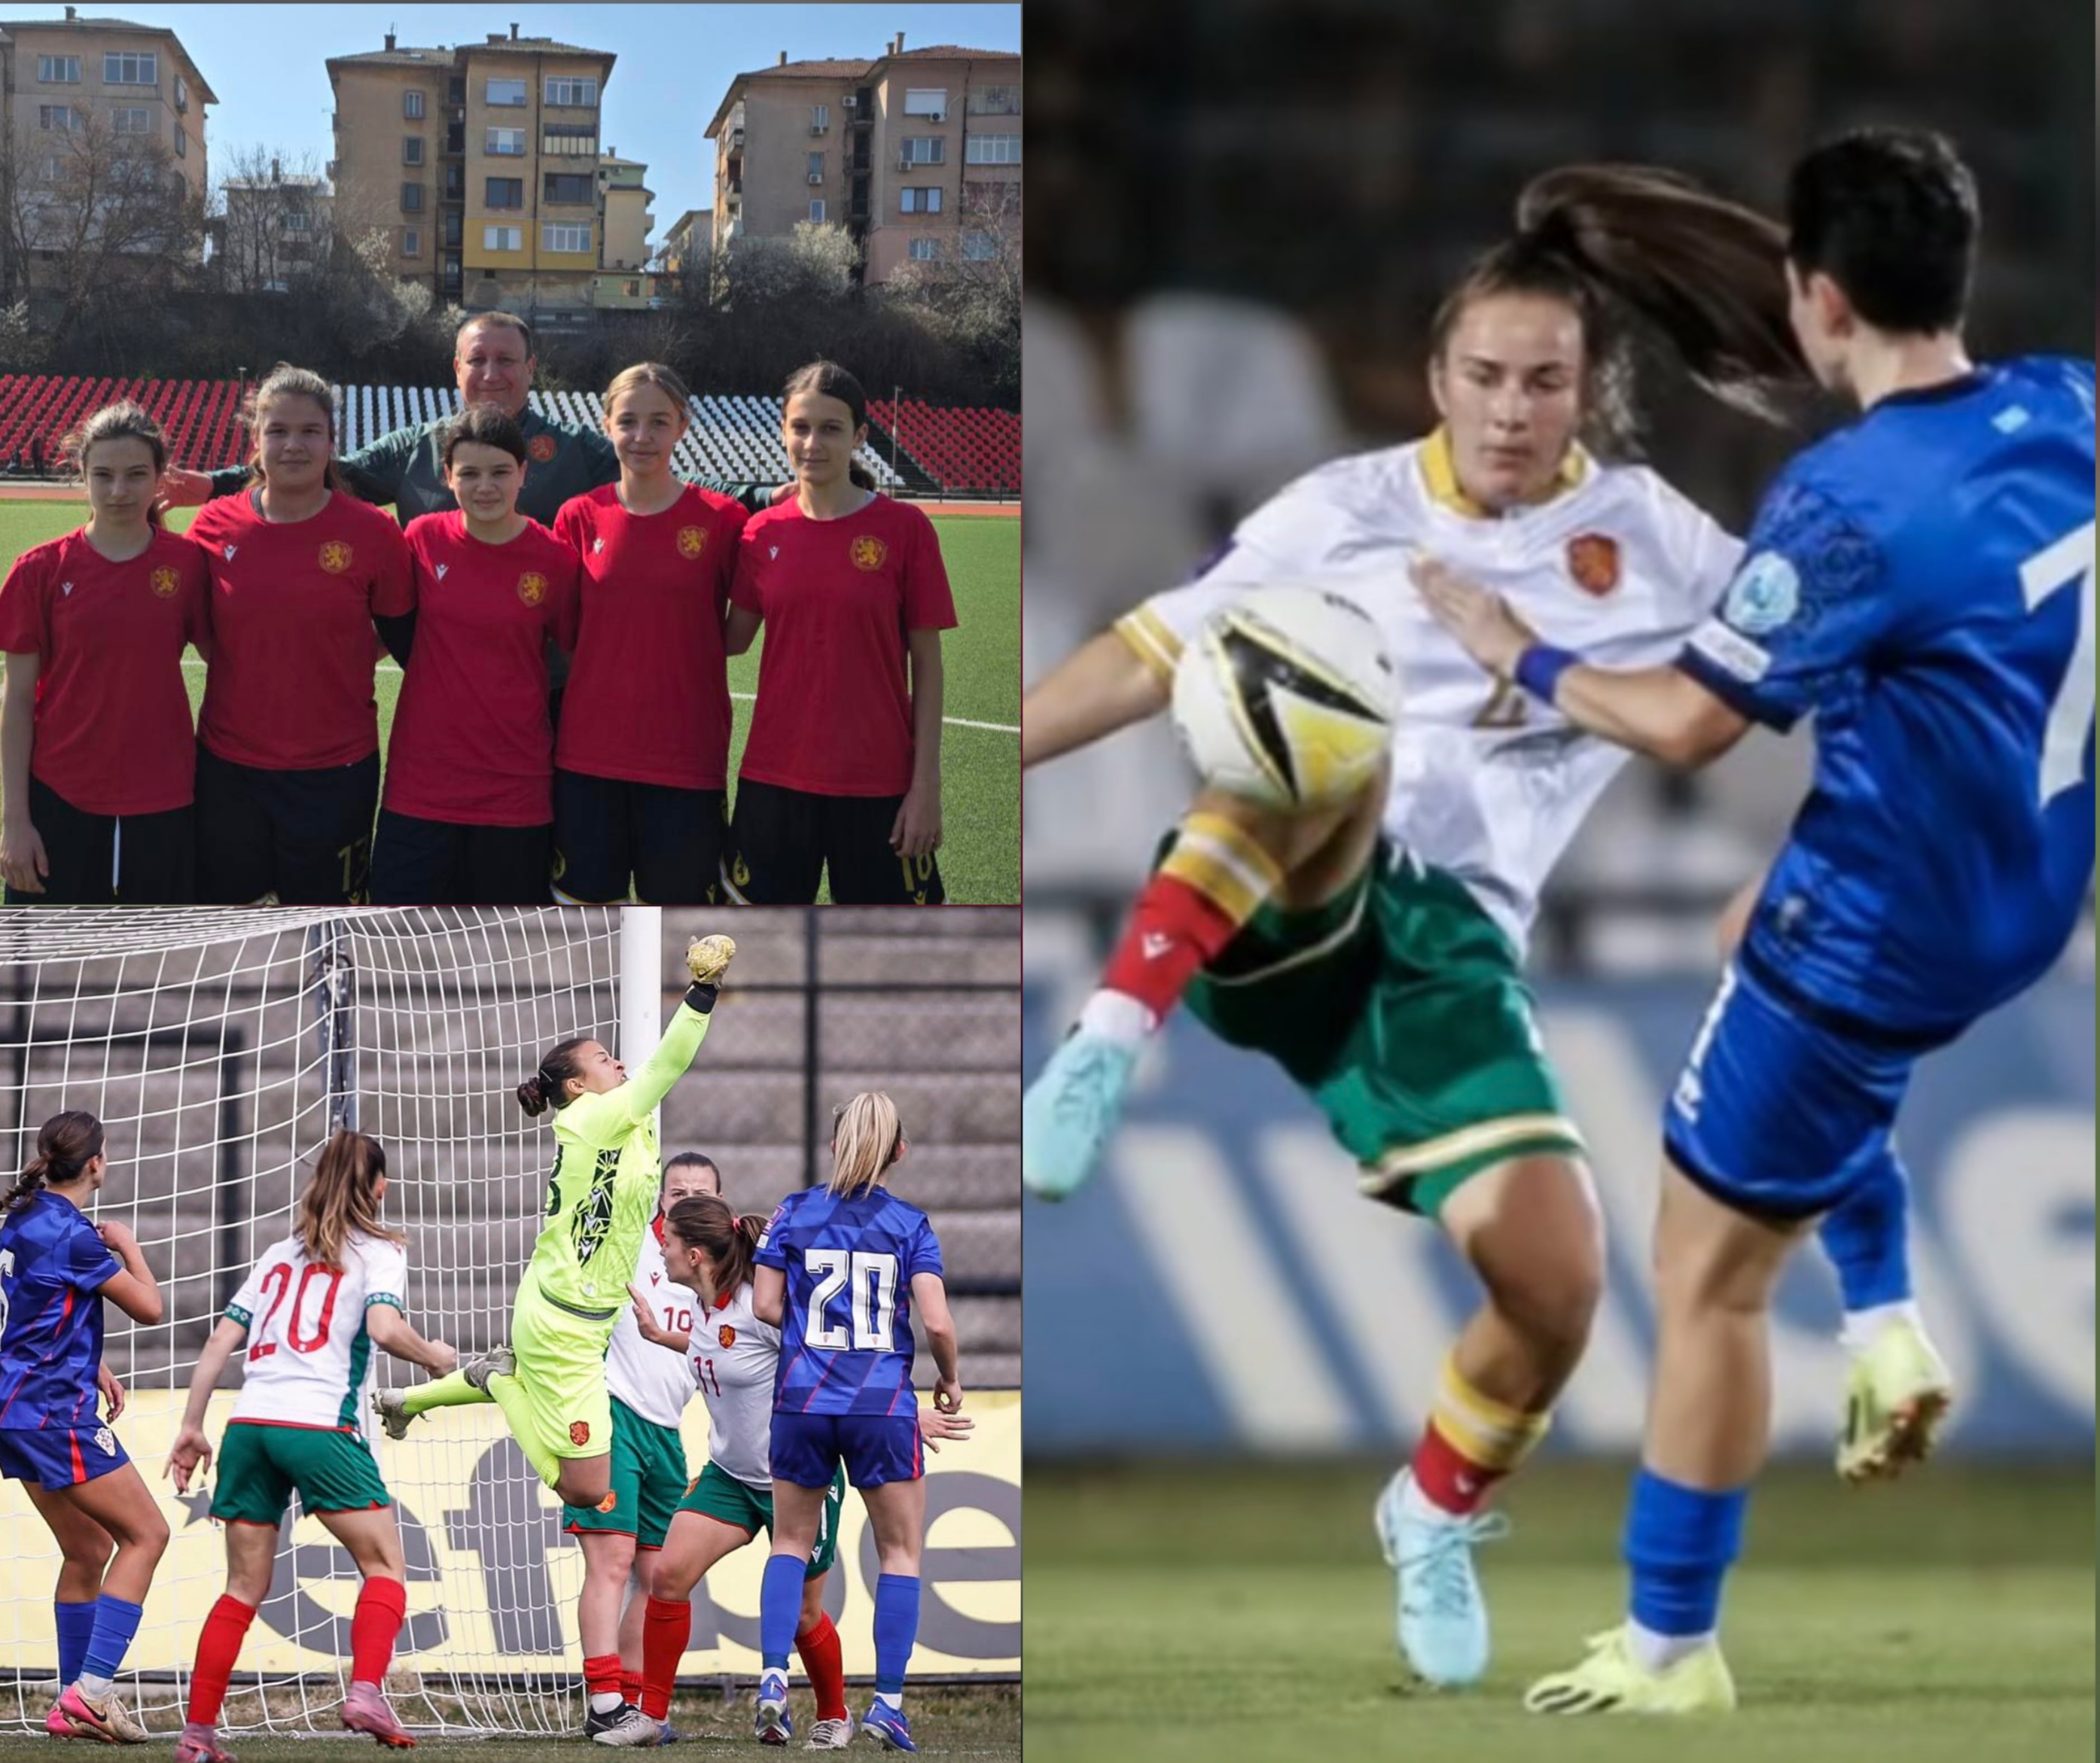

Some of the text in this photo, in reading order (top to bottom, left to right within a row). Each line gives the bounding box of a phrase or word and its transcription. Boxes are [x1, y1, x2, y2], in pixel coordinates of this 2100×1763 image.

[249, 1262, 343, 1362] 20
[663, 1306, 692, 1332] 10
[805, 1248, 898, 1353] 20
[693, 1356, 721, 1397] 11
